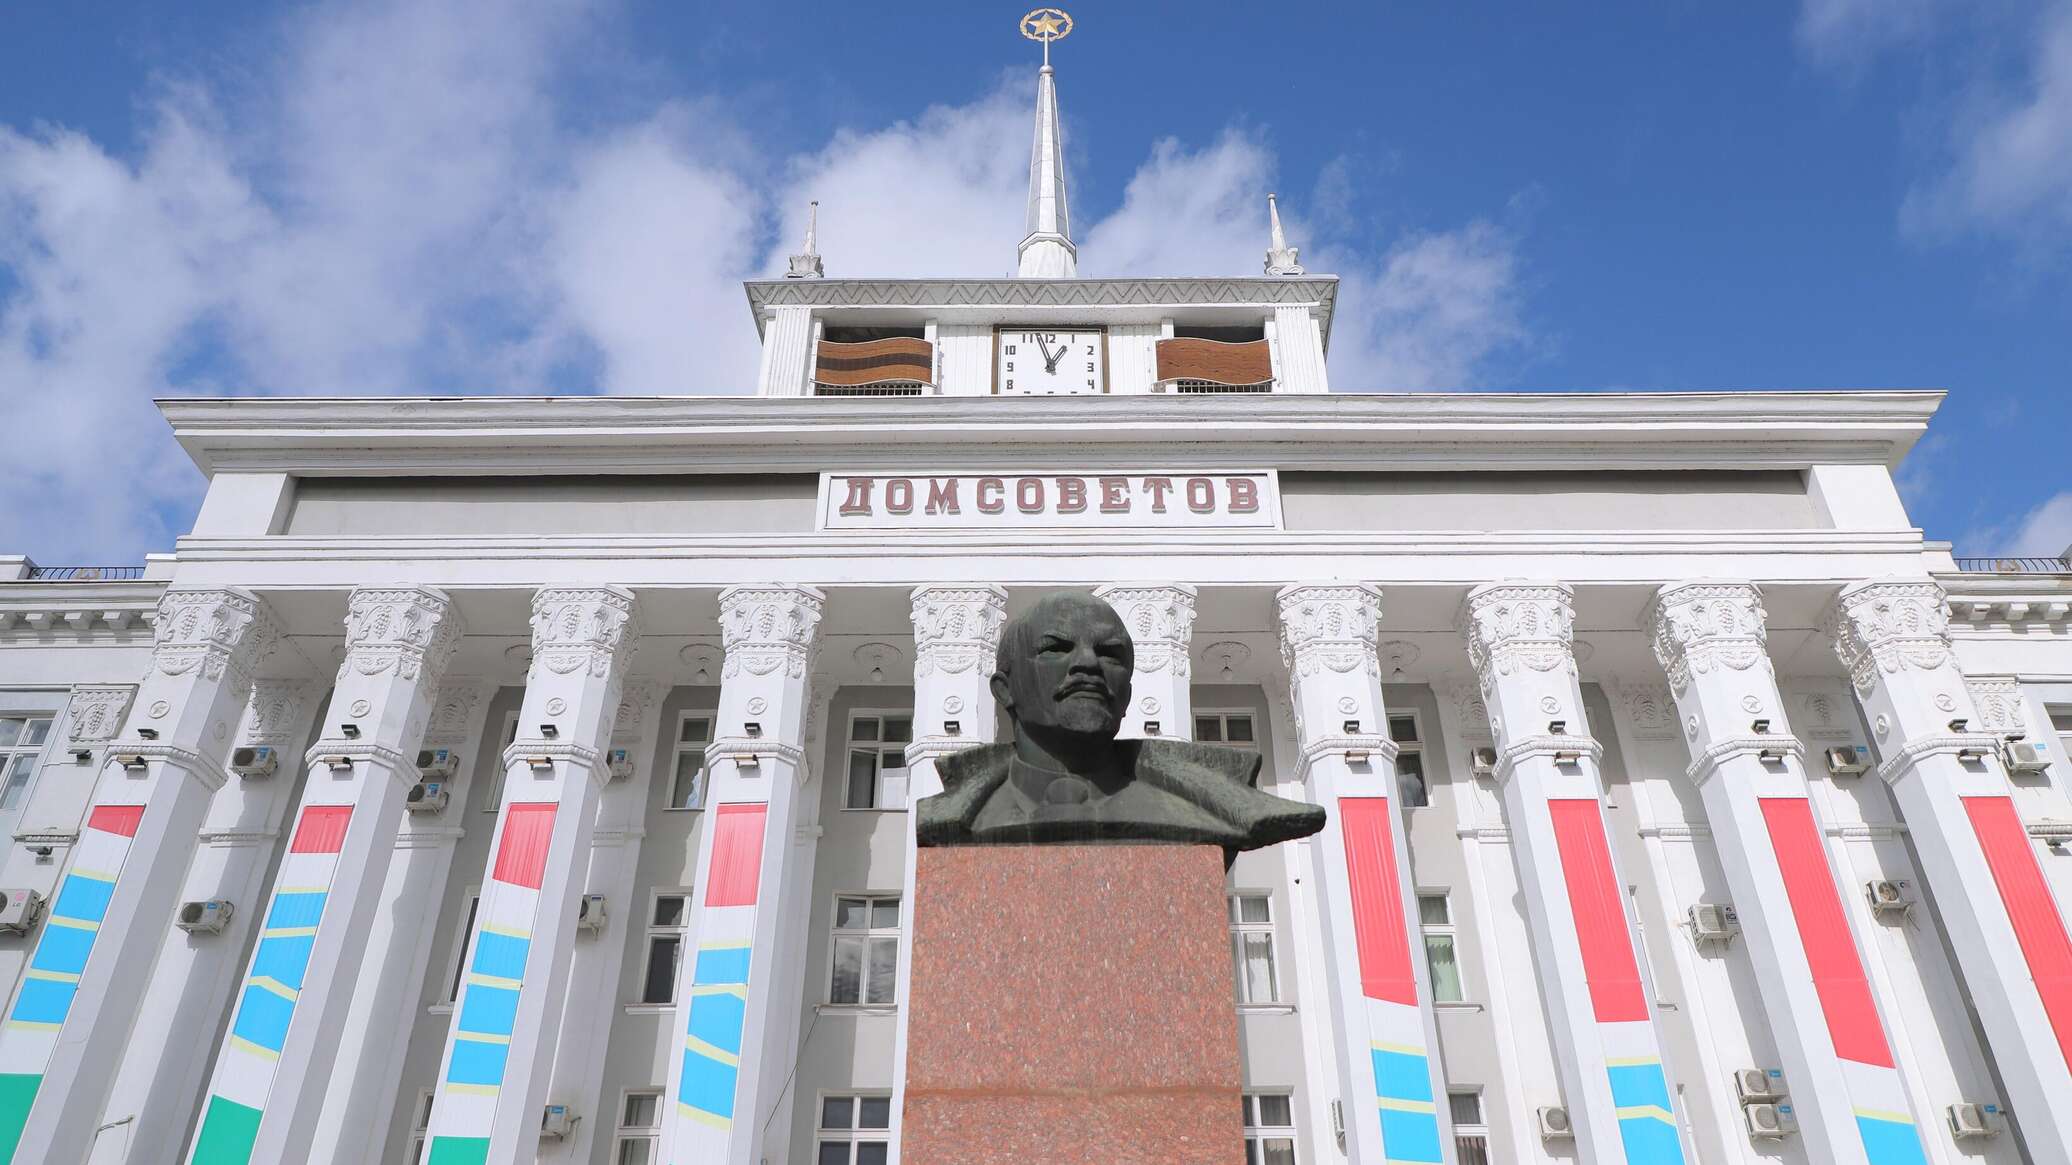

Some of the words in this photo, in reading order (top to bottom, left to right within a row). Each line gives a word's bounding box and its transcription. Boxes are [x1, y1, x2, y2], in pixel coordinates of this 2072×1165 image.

[1022, 334, 1033, 343] 11
[1045, 334, 1056, 343] 12
[1005, 345, 1016, 355] 10
[1087, 345, 1094, 355] 2
[1007, 362, 1014, 372] 9
[1087, 362, 1094, 372] 3
[1006, 380, 1013, 389] 8
[1087, 380, 1094, 389] 4
[839, 478, 961, 516] ДОМ
[976, 477, 1259, 515] СОВЕТОВ
